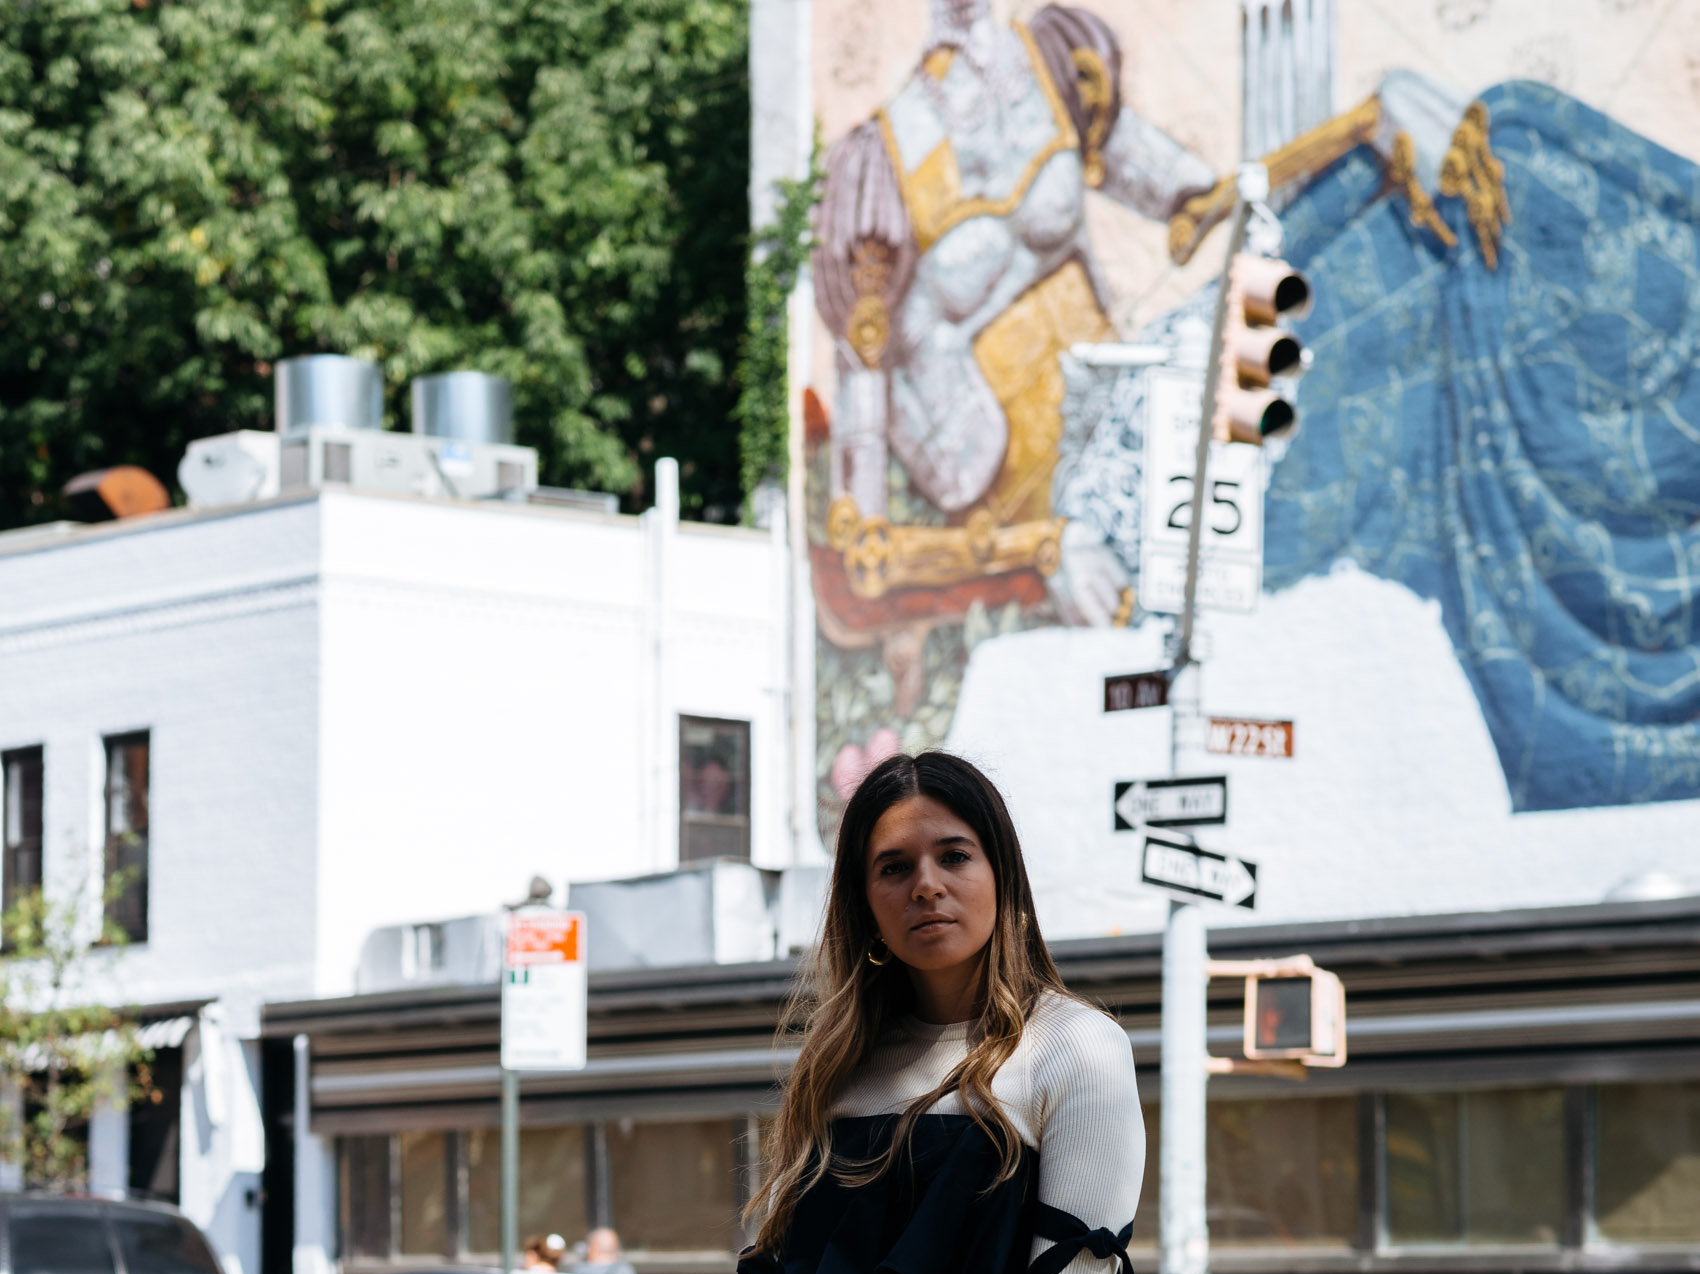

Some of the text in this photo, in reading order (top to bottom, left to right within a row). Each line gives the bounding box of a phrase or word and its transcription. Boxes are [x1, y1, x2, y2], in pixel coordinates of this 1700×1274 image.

[1168, 476, 1242, 534] 25
[1230, 722, 1261, 755] 22
[1130, 793, 1214, 814] ONE WAY
